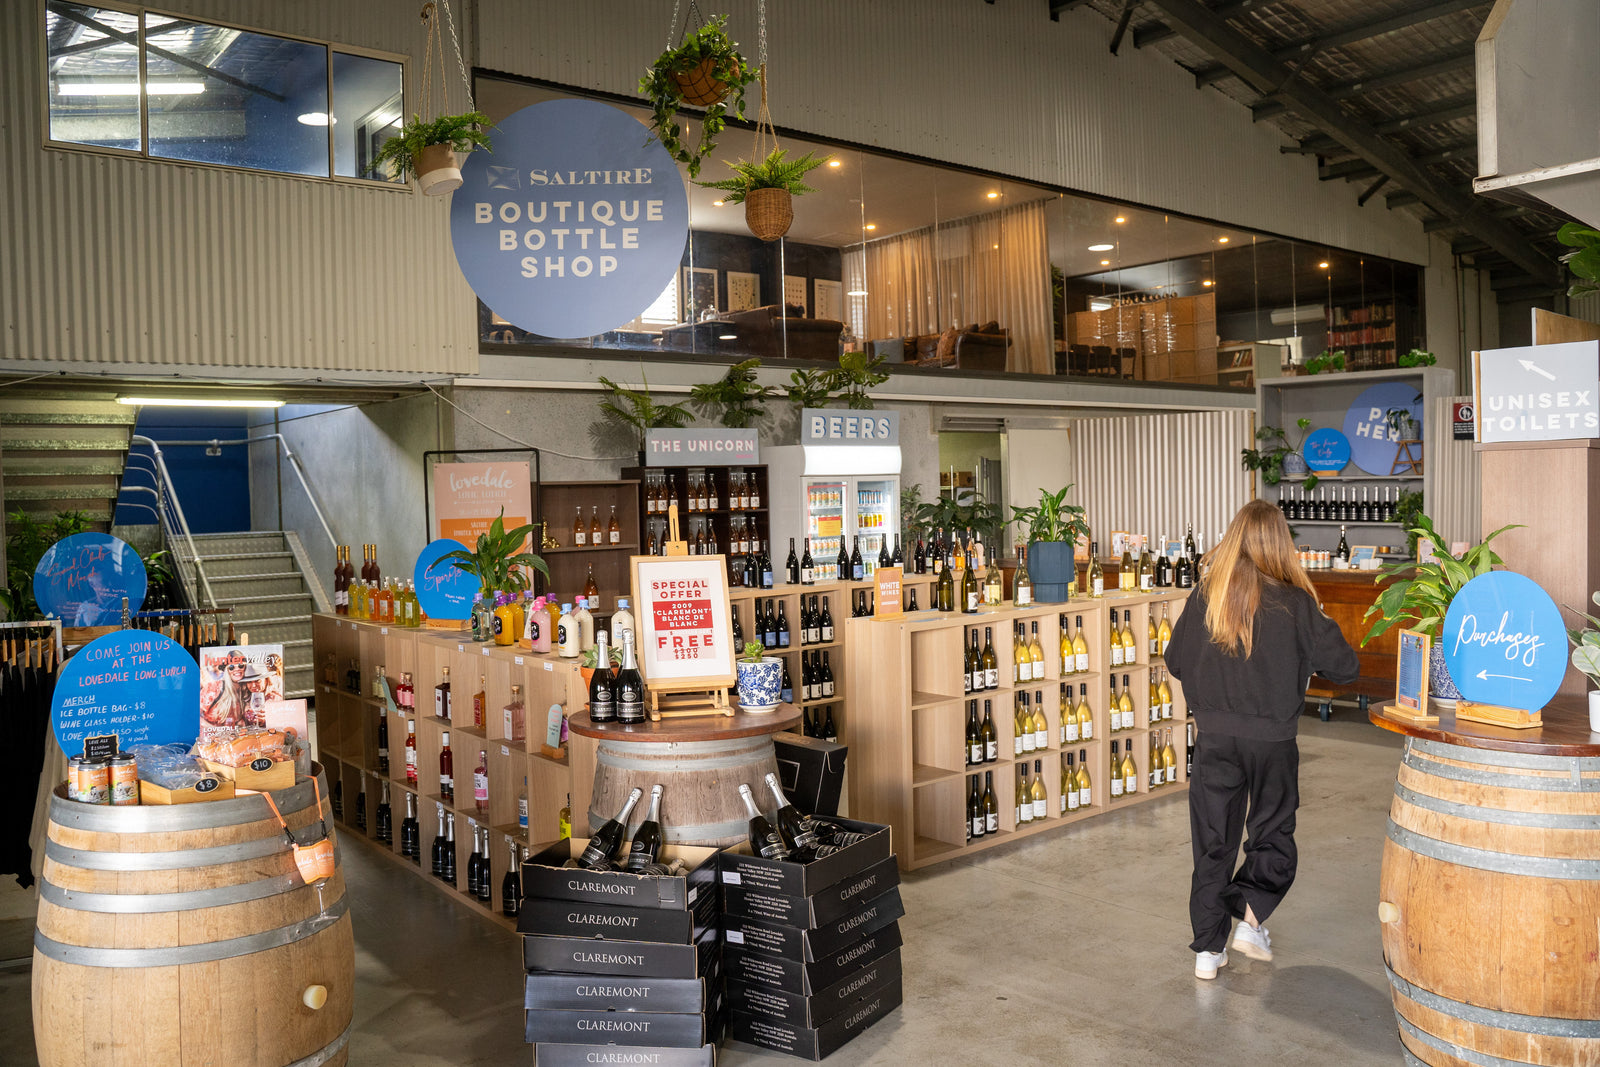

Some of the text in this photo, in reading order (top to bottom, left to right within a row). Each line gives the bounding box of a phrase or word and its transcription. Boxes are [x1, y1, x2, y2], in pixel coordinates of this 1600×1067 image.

[530, 167, 652, 186] SALTIRE
[475, 200, 664, 226] BOUTIQUE
[499, 228, 639, 251] BOTTLE
[520, 255, 618, 278] SHOP
[1488, 390, 1591, 411] UNISEX
[811, 415, 891, 439] BEERS
[1481, 411, 1599, 433] TOILETS
[1356, 422, 1401, 443] HER
[651, 439, 754, 453] THE UNICORN
[449, 466, 516, 493] lovedale
[652, 580, 708, 589] SPECIAL
[880, 581, 900, 590] WHITE
[660, 590, 702, 599] OFFER
[658, 634, 714, 648] FREE
[1453, 610, 1545, 667] Purchases
[86, 639, 170, 661] COME JOIN US
[112, 653, 152, 669] AT THE
[79, 666, 187, 687] LOVEDALE LONG LUNCH
[62, 694, 96, 707] MERCH
[60, 709, 73, 718] ICE
[78, 705, 108, 716] BOTTLE
[134, 701, 146, 711] $8
[60, 719, 81, 729] WINE
[84, 718, 107, 728] GLASS
[142, 712, 155, 721] $10
[62, 731, 83, 742] LOVE
[253, 759, 269, 770] $10
[199, 779, 213, 790] $8
[568, 880, 636, 896] CLAREMONT
[840, 874, 877, 901] CLAREMONT
[567, 912, 639, 928] CLAREMONT
[837, 907, 878, 934] CLAREMONT
[573, 951, 645, 966] CLAREMONT
[836, 938, 877, 967] CLAREMONT
[576, 985, 651, 998] CLAREMONT
[838, 968, 878, 999] CLAREMONT
[844, 998, 881, 1030] CLAREMONT
[576, 1019, 651, 1033] CLAREMONT
[586, 1052, 661, 1064] CLAREMONT
